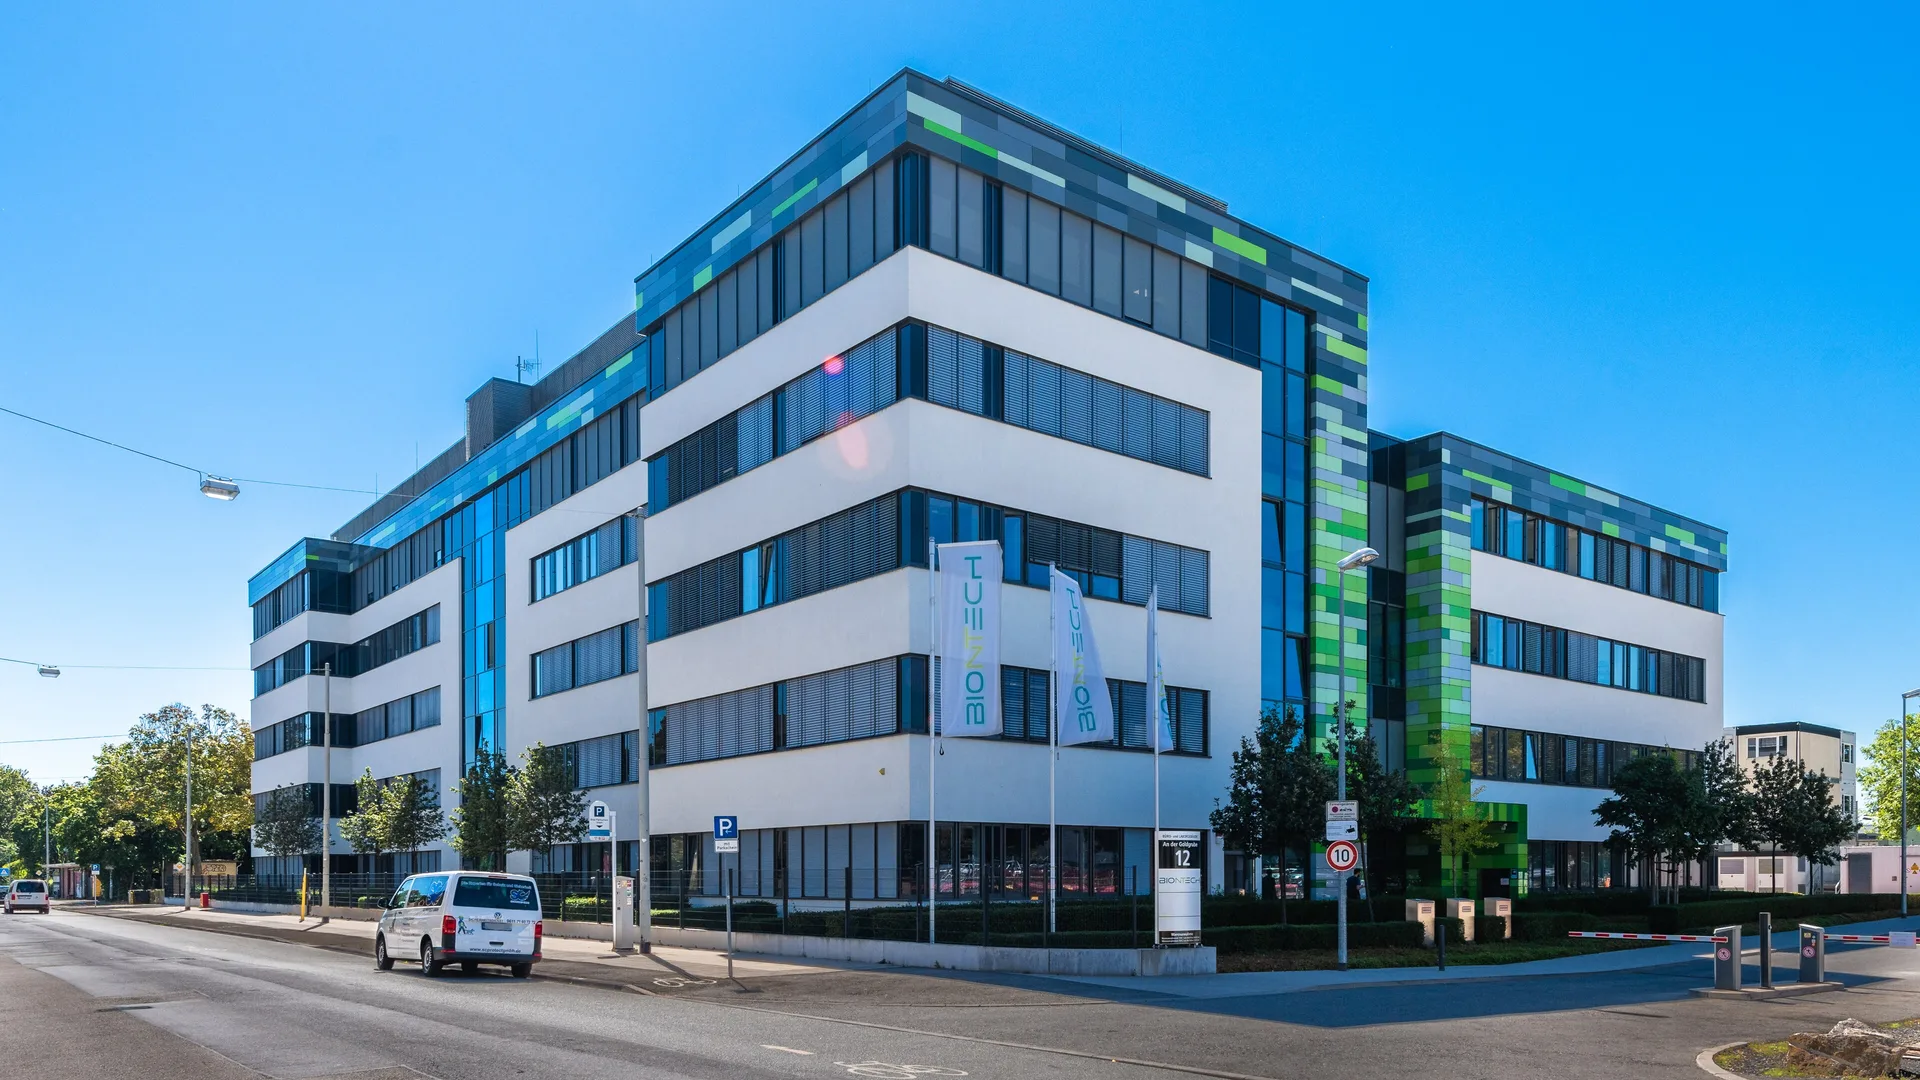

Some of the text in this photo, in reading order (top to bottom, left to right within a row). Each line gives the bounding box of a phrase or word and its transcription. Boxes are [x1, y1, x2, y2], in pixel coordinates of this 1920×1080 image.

[964, 556, 985, 725] BIONTECH
[1066, 587, 1097, 733] BIONTECH
[596, 807, 603, 816] P
[719, 818, 733, 837] P
[1175, 849, 1191, 866] 12
[1334, 848, 1350, 863] 10
